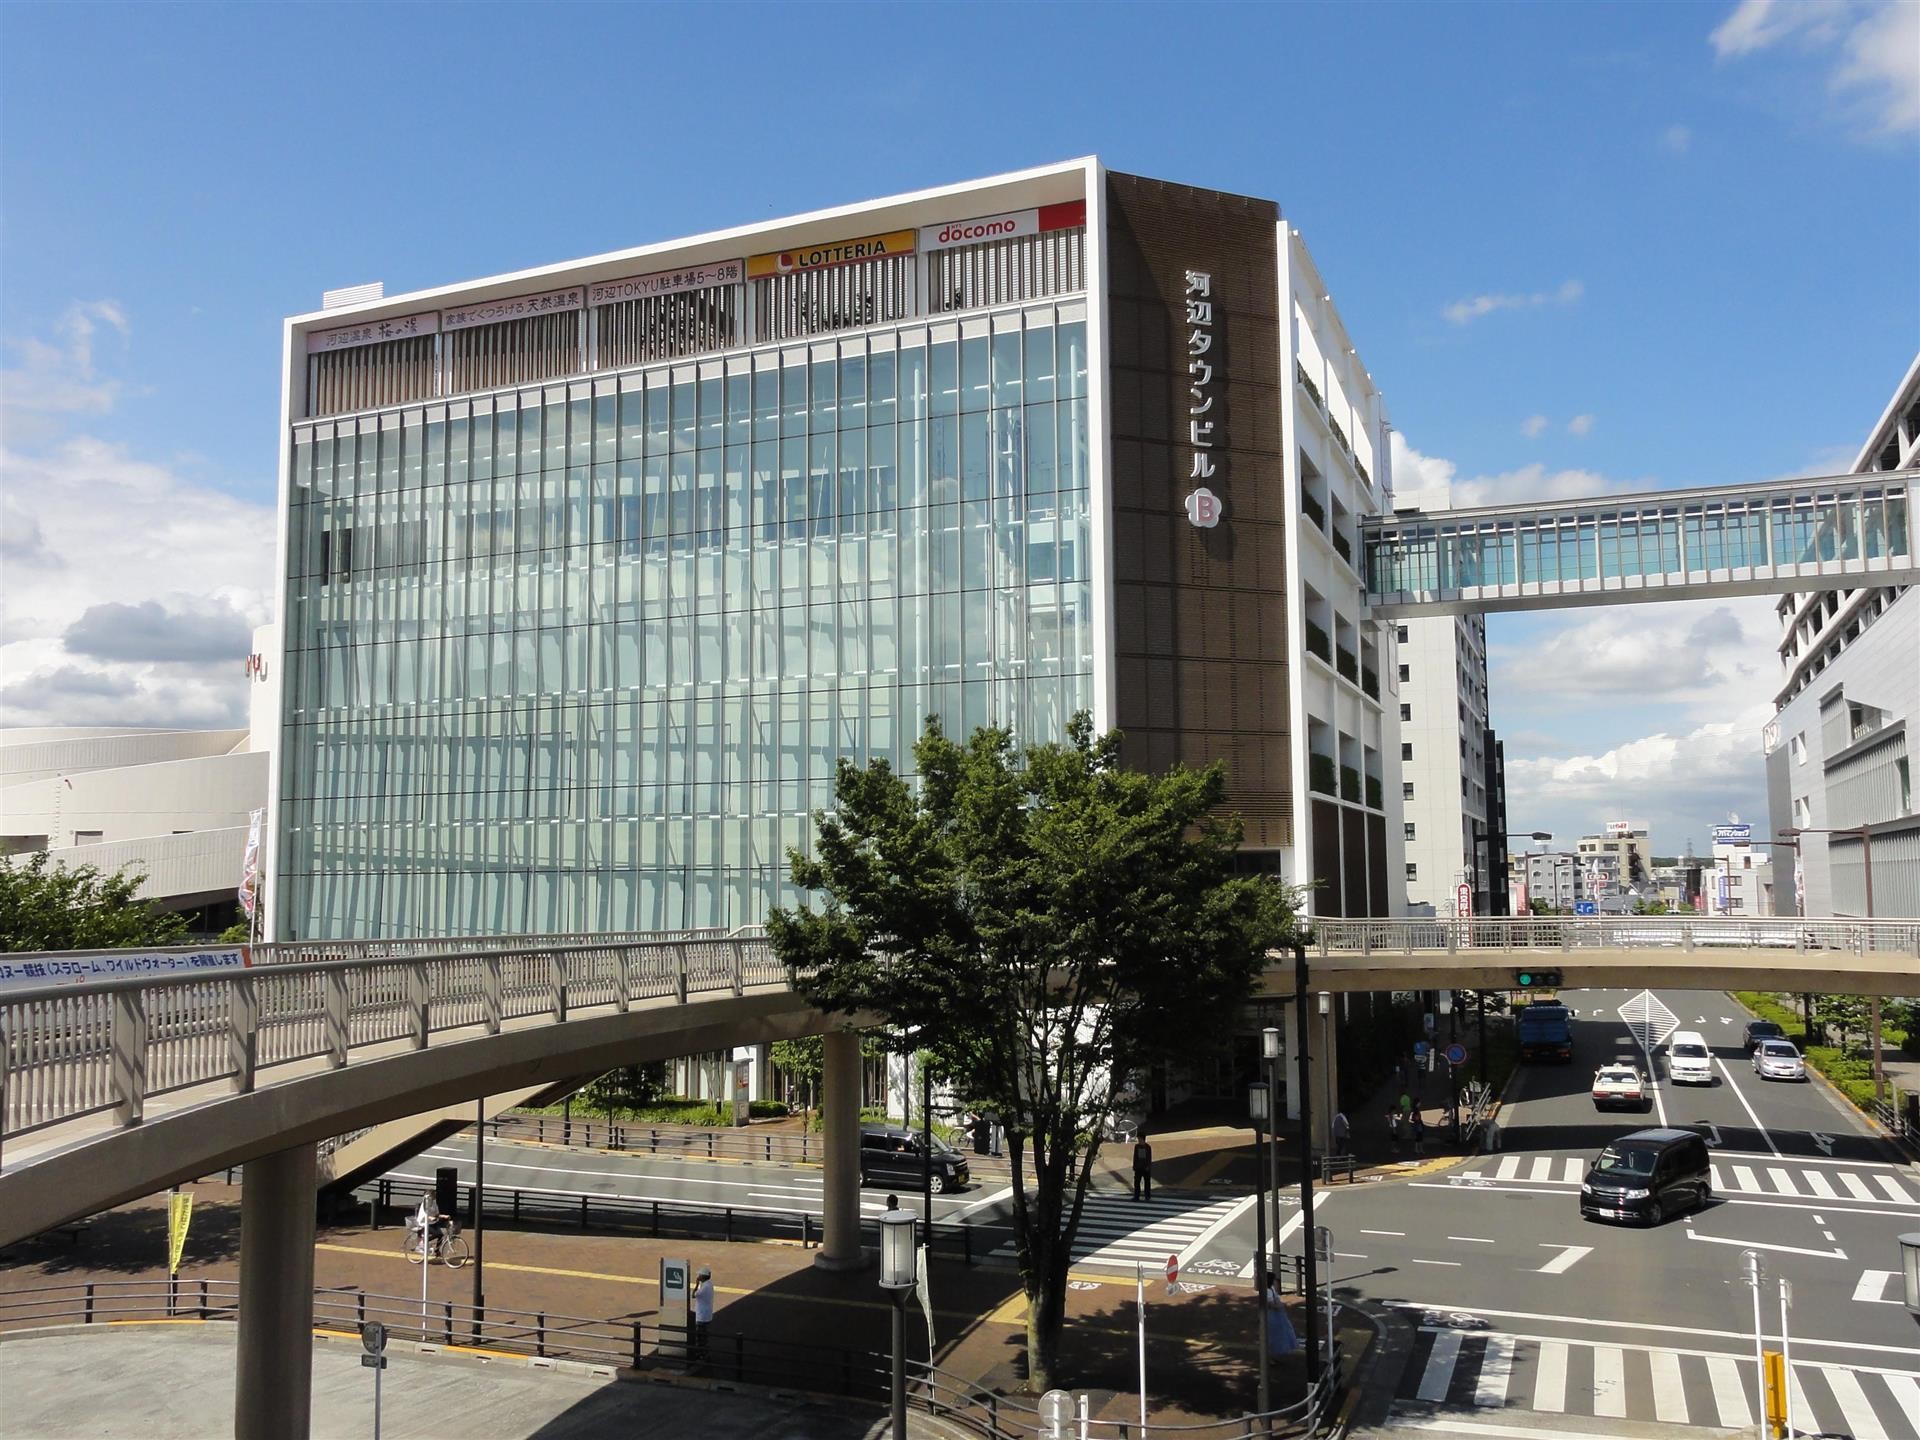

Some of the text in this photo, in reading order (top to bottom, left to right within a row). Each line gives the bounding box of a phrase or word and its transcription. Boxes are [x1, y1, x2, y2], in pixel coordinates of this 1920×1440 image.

[938, 219, 1016, 244] docomo
[799, 240, 887, 267] LOTTERIA
[527, 291, 579, 313] 天然温泉
[1186, 269, 1216, 478] 河辺タウンビル
[1195, 494, 1214, 522] B
